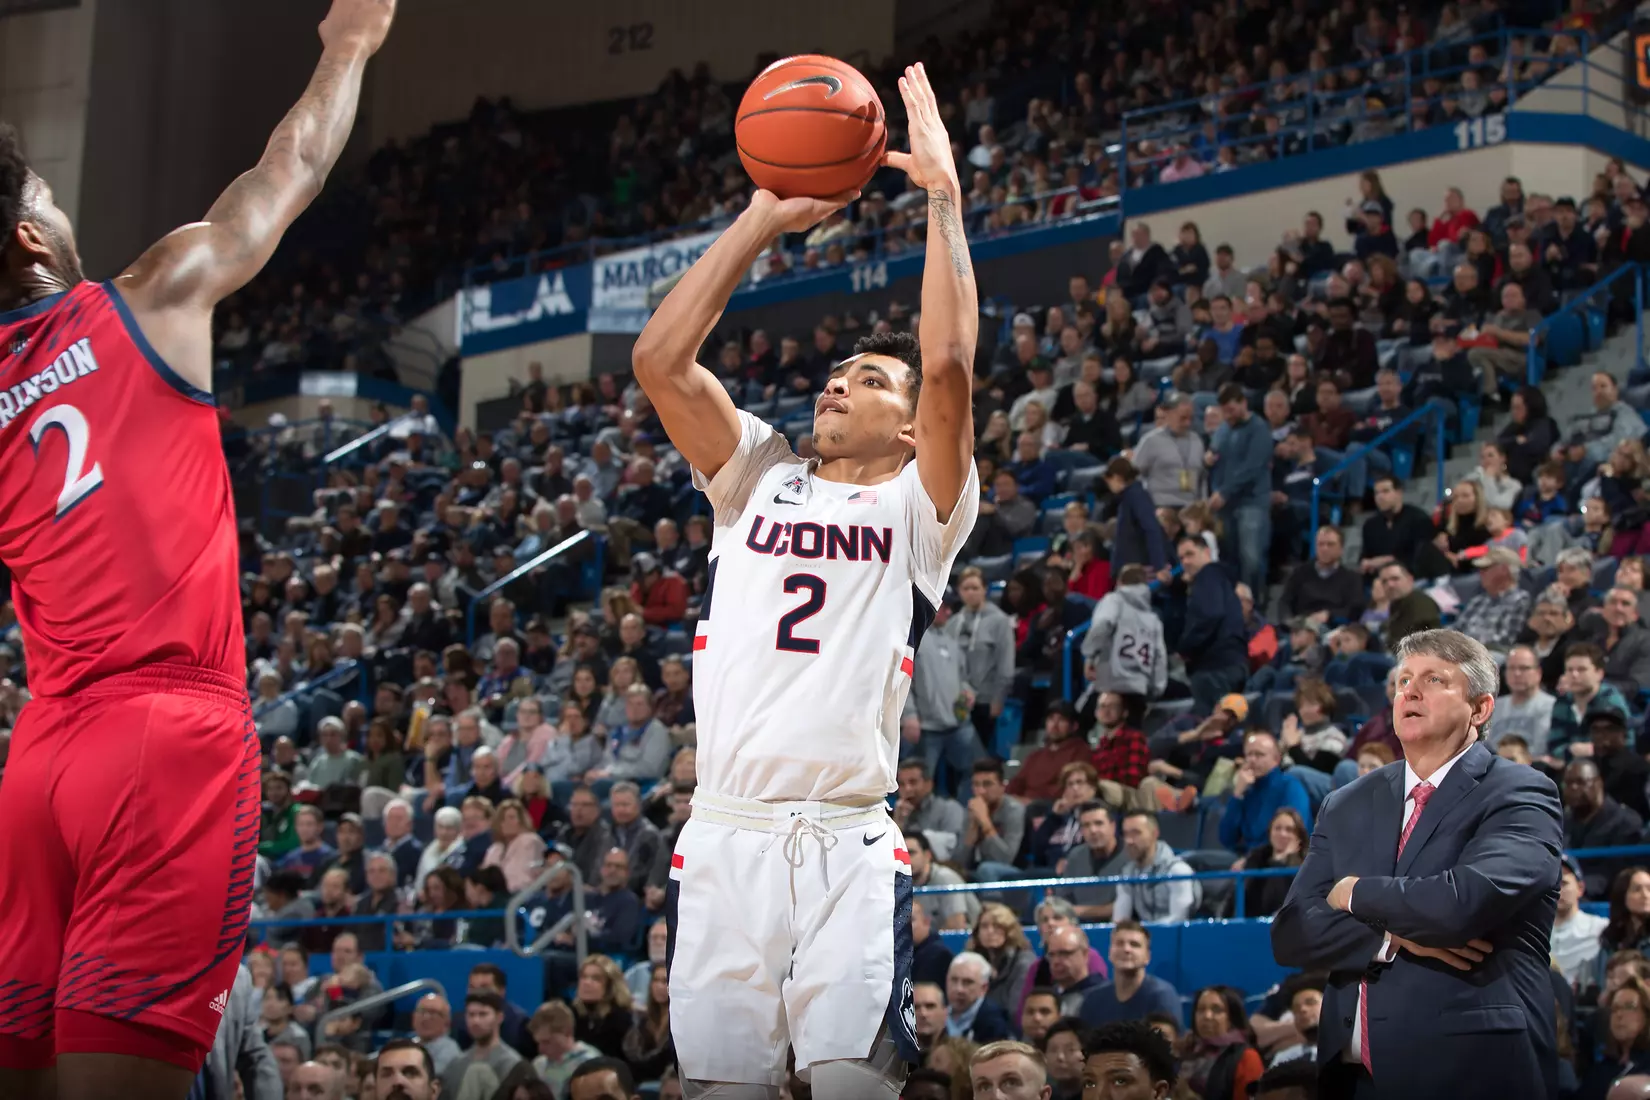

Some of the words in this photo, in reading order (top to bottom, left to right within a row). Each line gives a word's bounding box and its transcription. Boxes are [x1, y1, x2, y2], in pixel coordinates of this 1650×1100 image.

[607, 22, 655, 55] 212
[1453, 114, 1507, 149] 115
[850, 261, 888, 292] 114
[28, 403, 105, 524] 2
[746, 514, 893, 564] UCONN
[775, 573, 827, 655] 2
[1118, 634, 1151, 667] 24
